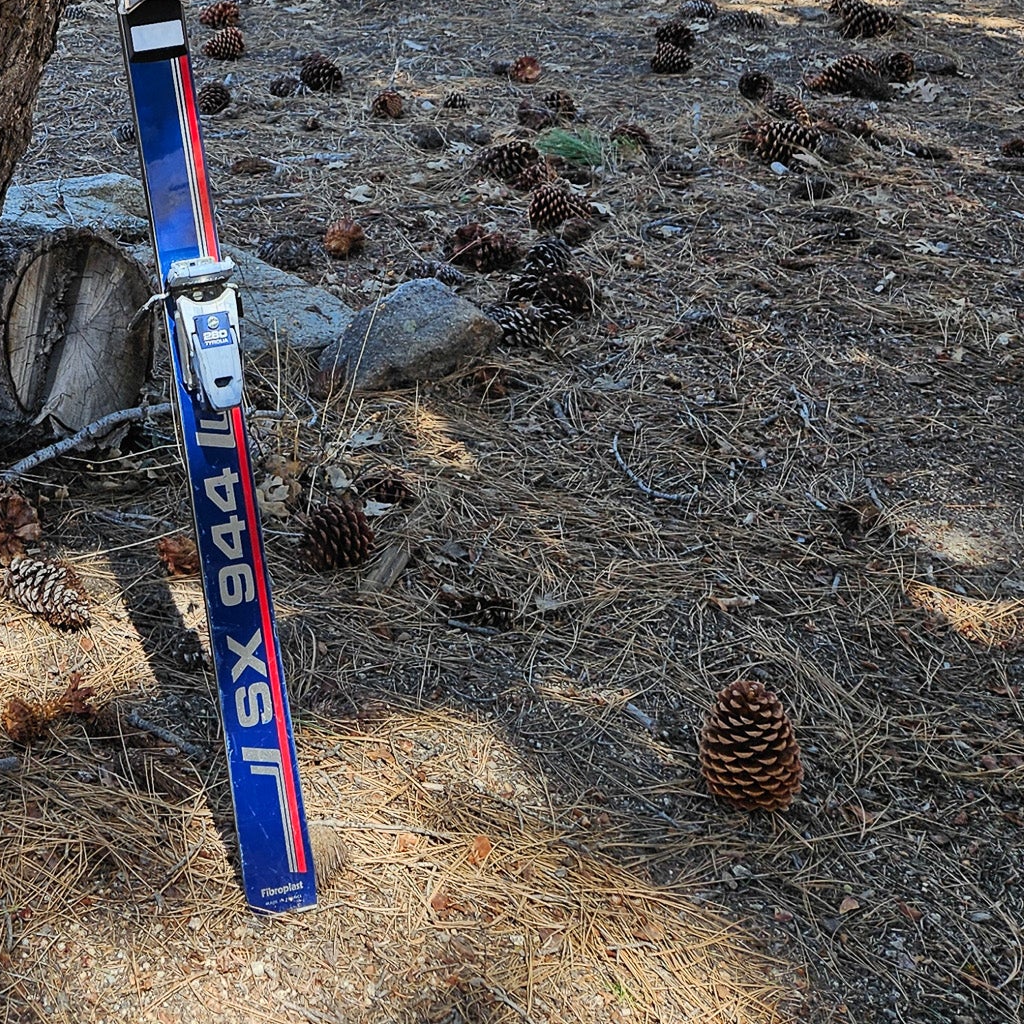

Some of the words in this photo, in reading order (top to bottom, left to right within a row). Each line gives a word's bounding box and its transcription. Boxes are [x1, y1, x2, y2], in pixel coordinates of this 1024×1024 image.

[202, 329, 228, 341] 280
[204, 467, 255, 607] 944
[226, 627, 273, 728] SX
[260, 880, 304, 898] Fibroplast
